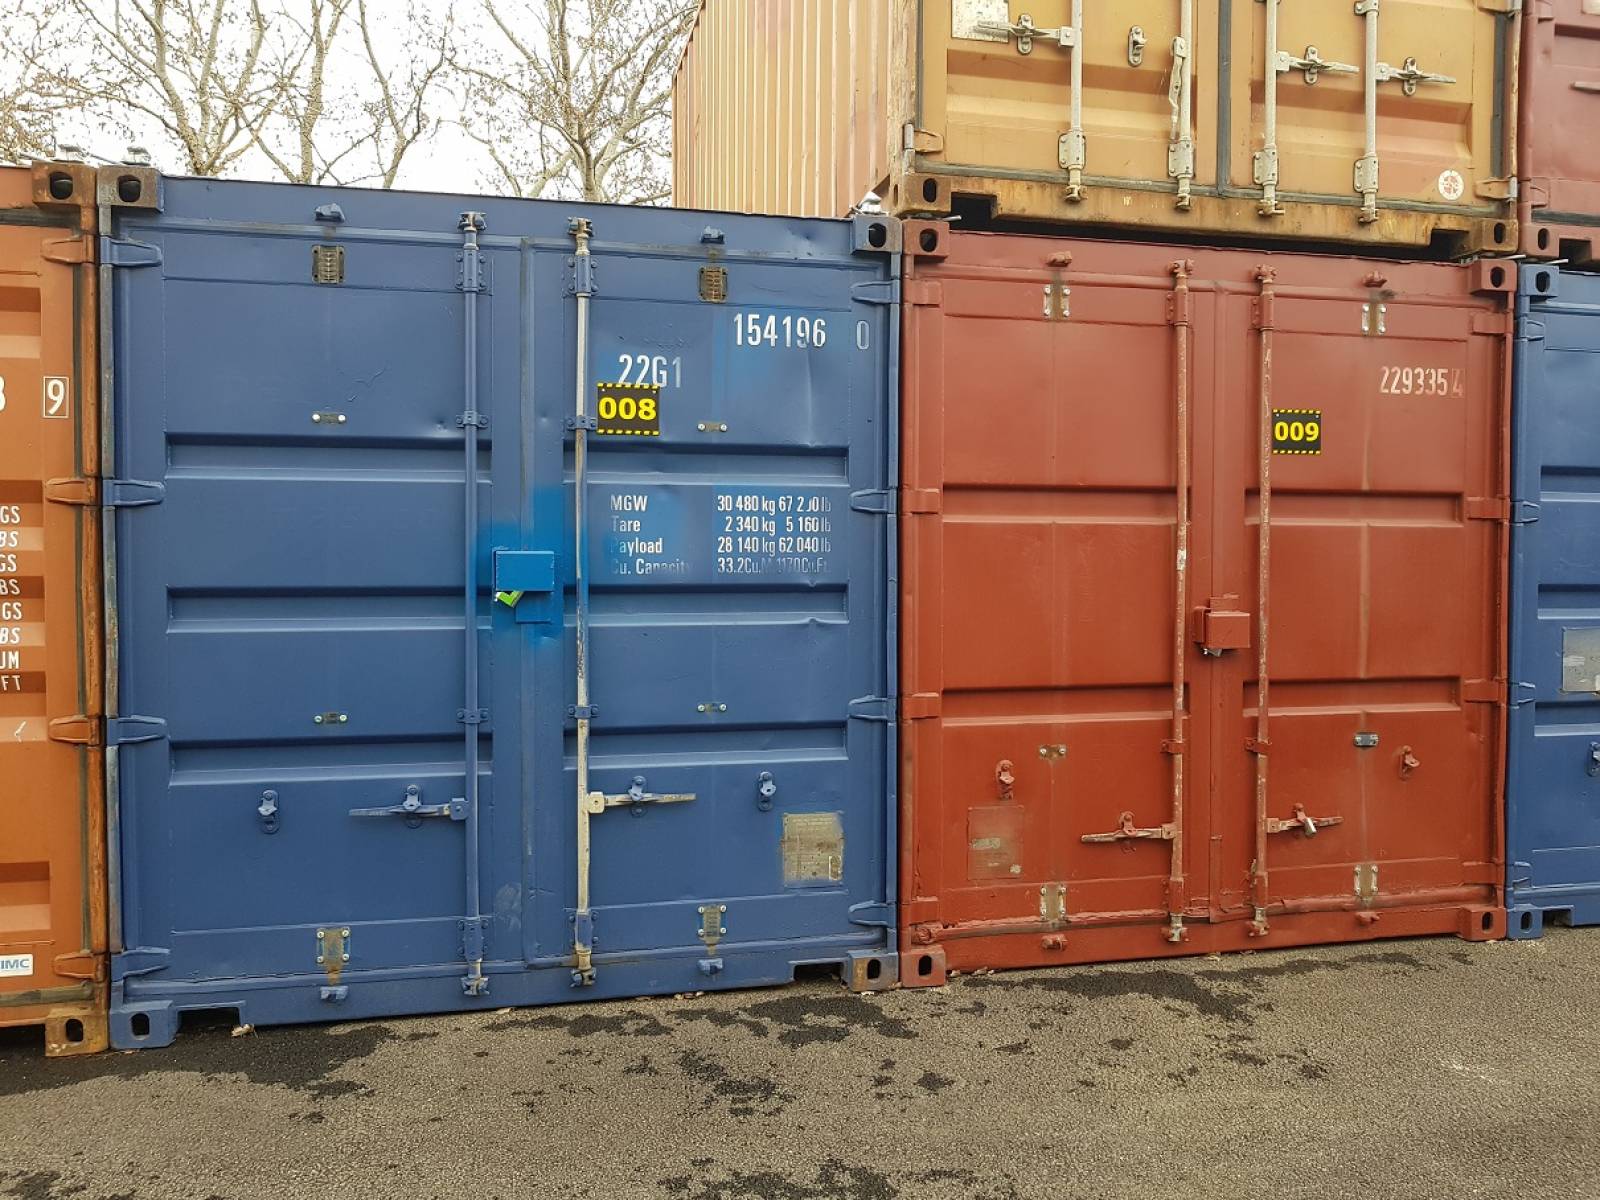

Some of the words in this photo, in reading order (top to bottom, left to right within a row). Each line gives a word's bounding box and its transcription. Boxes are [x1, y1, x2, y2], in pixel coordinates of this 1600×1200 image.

[733, 313, 826, 348] 154196
[618, 354, 682, 389] 22G1
[1380, 366, 1449, 396] 229335
[48, 379, 64, 415] 9
[599, 397, 656, 420] 008
[1274, 421, 1319, 442] 009
[610, 494, 648, 512] MGW
[717, 495, 732, 511] 30
[735, 495, 759, 512] 480
[762, 496, 776, 516] kg
[778, 496, 793, 512] 67
[611, 515, 641, 533] Tare
[725, 516, 733, 532] 2
[736, 516, 759, 532] 340
[762, 516, 776, 536] kg
[786, 517, 793, 532] 5
[611, 537, 663, 557] ayload
[717, 537, 732, 553] 28
[737, 537, 759, 553] 140
[762, 537, 776, 557] kg
[778, 537, 793, 553] 62
